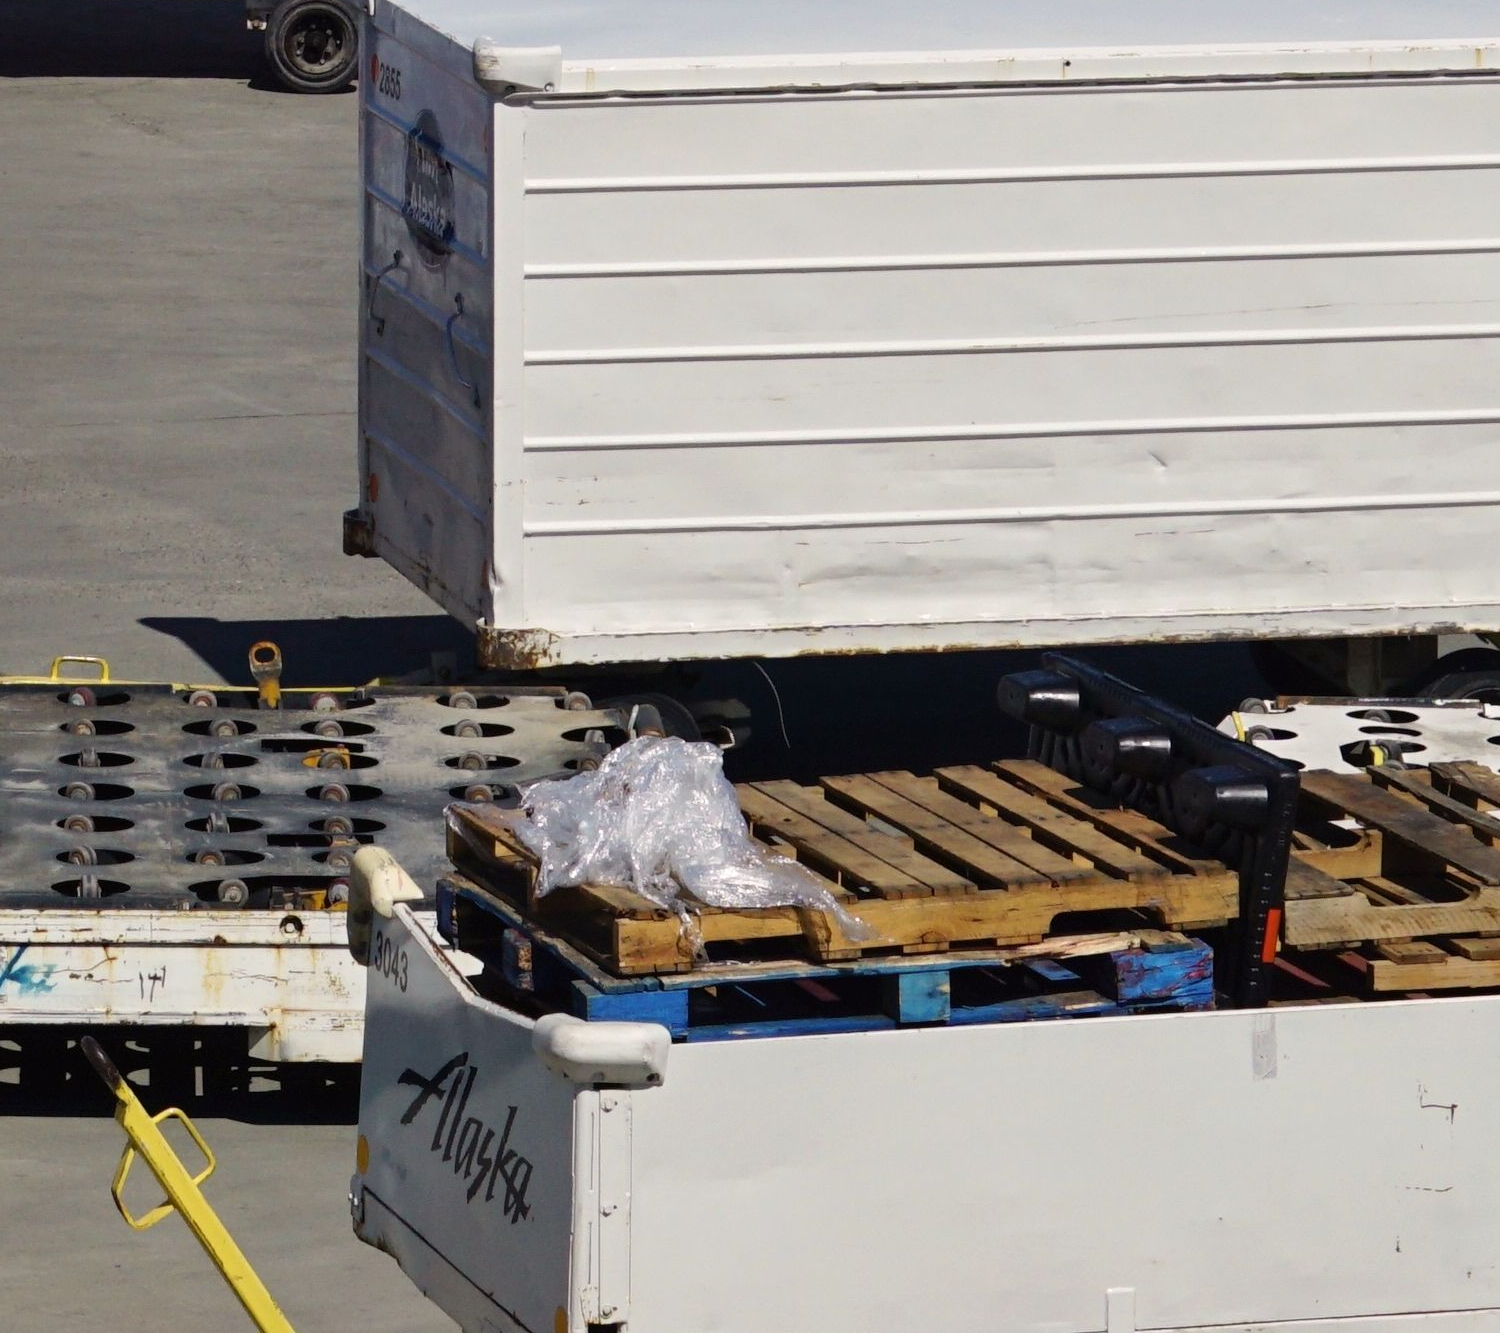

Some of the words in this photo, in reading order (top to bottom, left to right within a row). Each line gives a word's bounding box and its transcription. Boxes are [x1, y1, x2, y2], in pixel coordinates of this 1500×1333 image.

[379, 62, 402, 101] 2855
[405, 181, 447, 238] Alaska
[373, 925, 410, 995] 3043
[397, 1051, 535, 1227] Alaska
